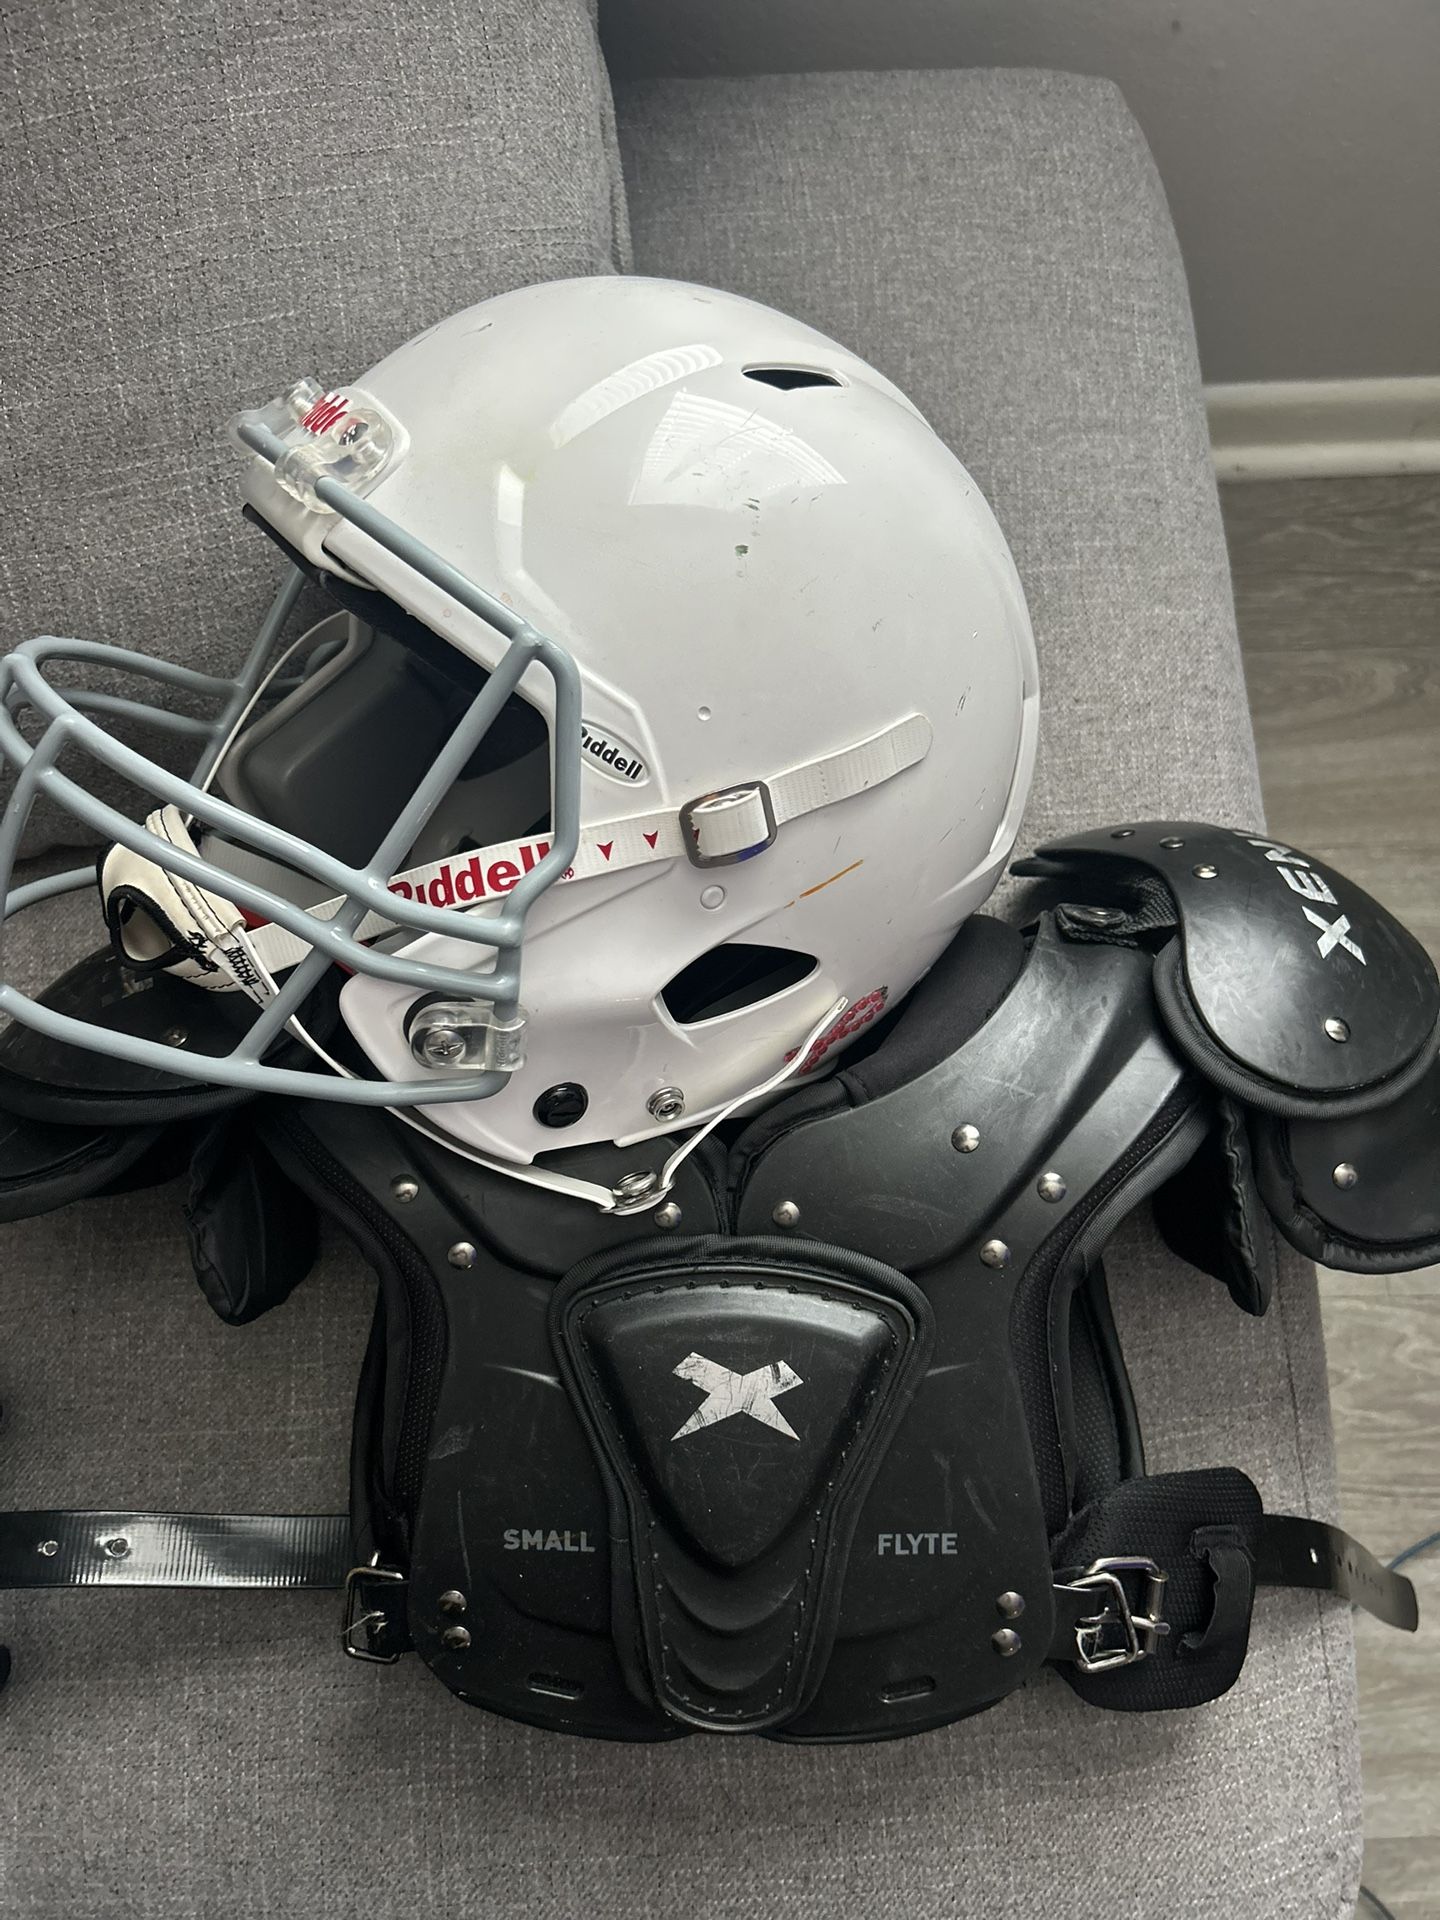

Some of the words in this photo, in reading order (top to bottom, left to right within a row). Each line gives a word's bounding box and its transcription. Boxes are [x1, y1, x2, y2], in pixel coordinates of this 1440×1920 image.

[581, 726, 643, 780] iddell
[503, 1528, 596, 1553] SMALL
[878, 1532, 958, 1556] FLYTE
